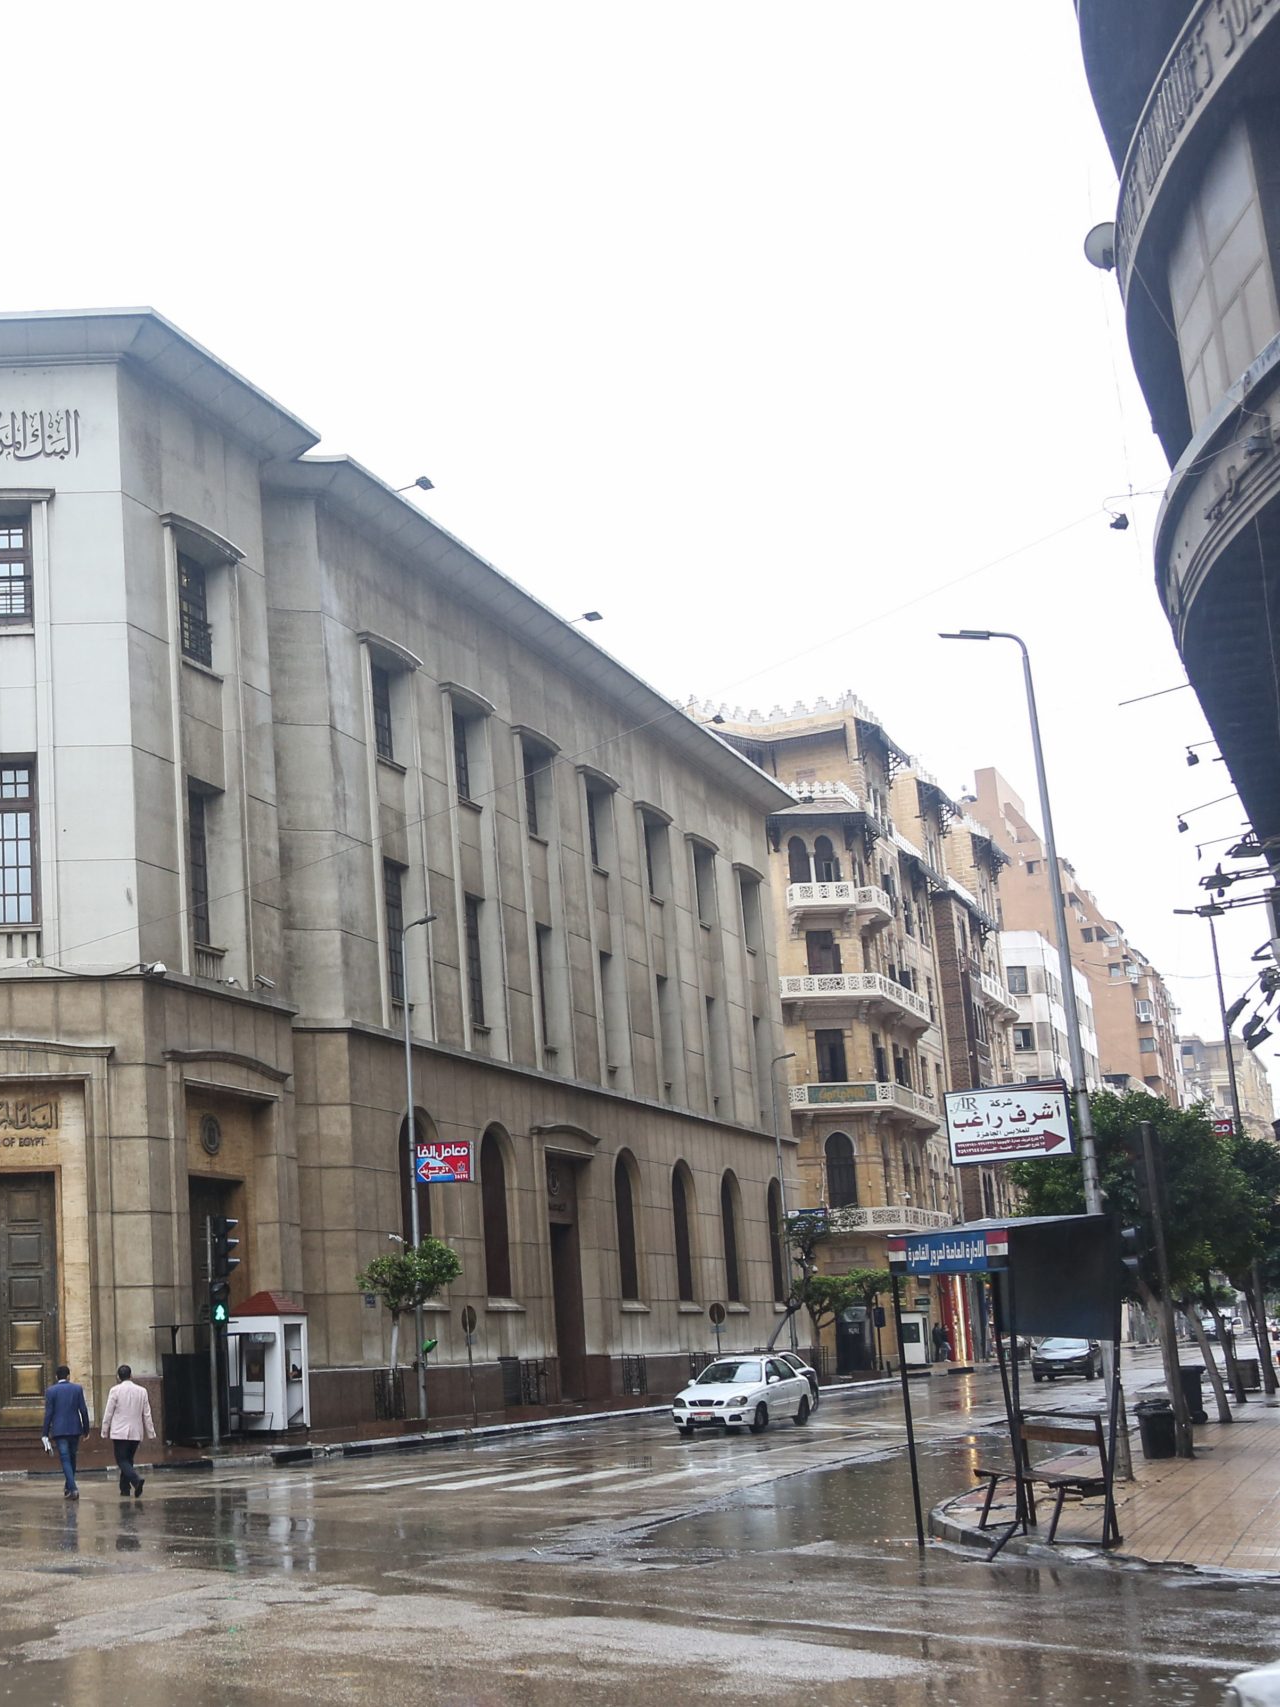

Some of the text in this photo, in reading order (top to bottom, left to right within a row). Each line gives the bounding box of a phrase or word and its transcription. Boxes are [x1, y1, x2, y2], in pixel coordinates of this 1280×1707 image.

[13, 408, 80, 461] البنك
[990, 1098, 1013, 1108] شركة
[13, 1101, 59, 1130] البنك
[952, 1100, 1062, 1132] أشرف راغب
[2, 1137, 16, 1148] OF
[18, 1136, 46, 1147] EGYPT
[976, 1127, 1030, 1138] للملابس الجاهزة
[417, 1144, 468, 1160] معامل الفا
[908, 1244, 929, 1267] القاهرة
[930, 1243, 945, 1266] لمرور
[946, 1241, 965, 1259] العامة
